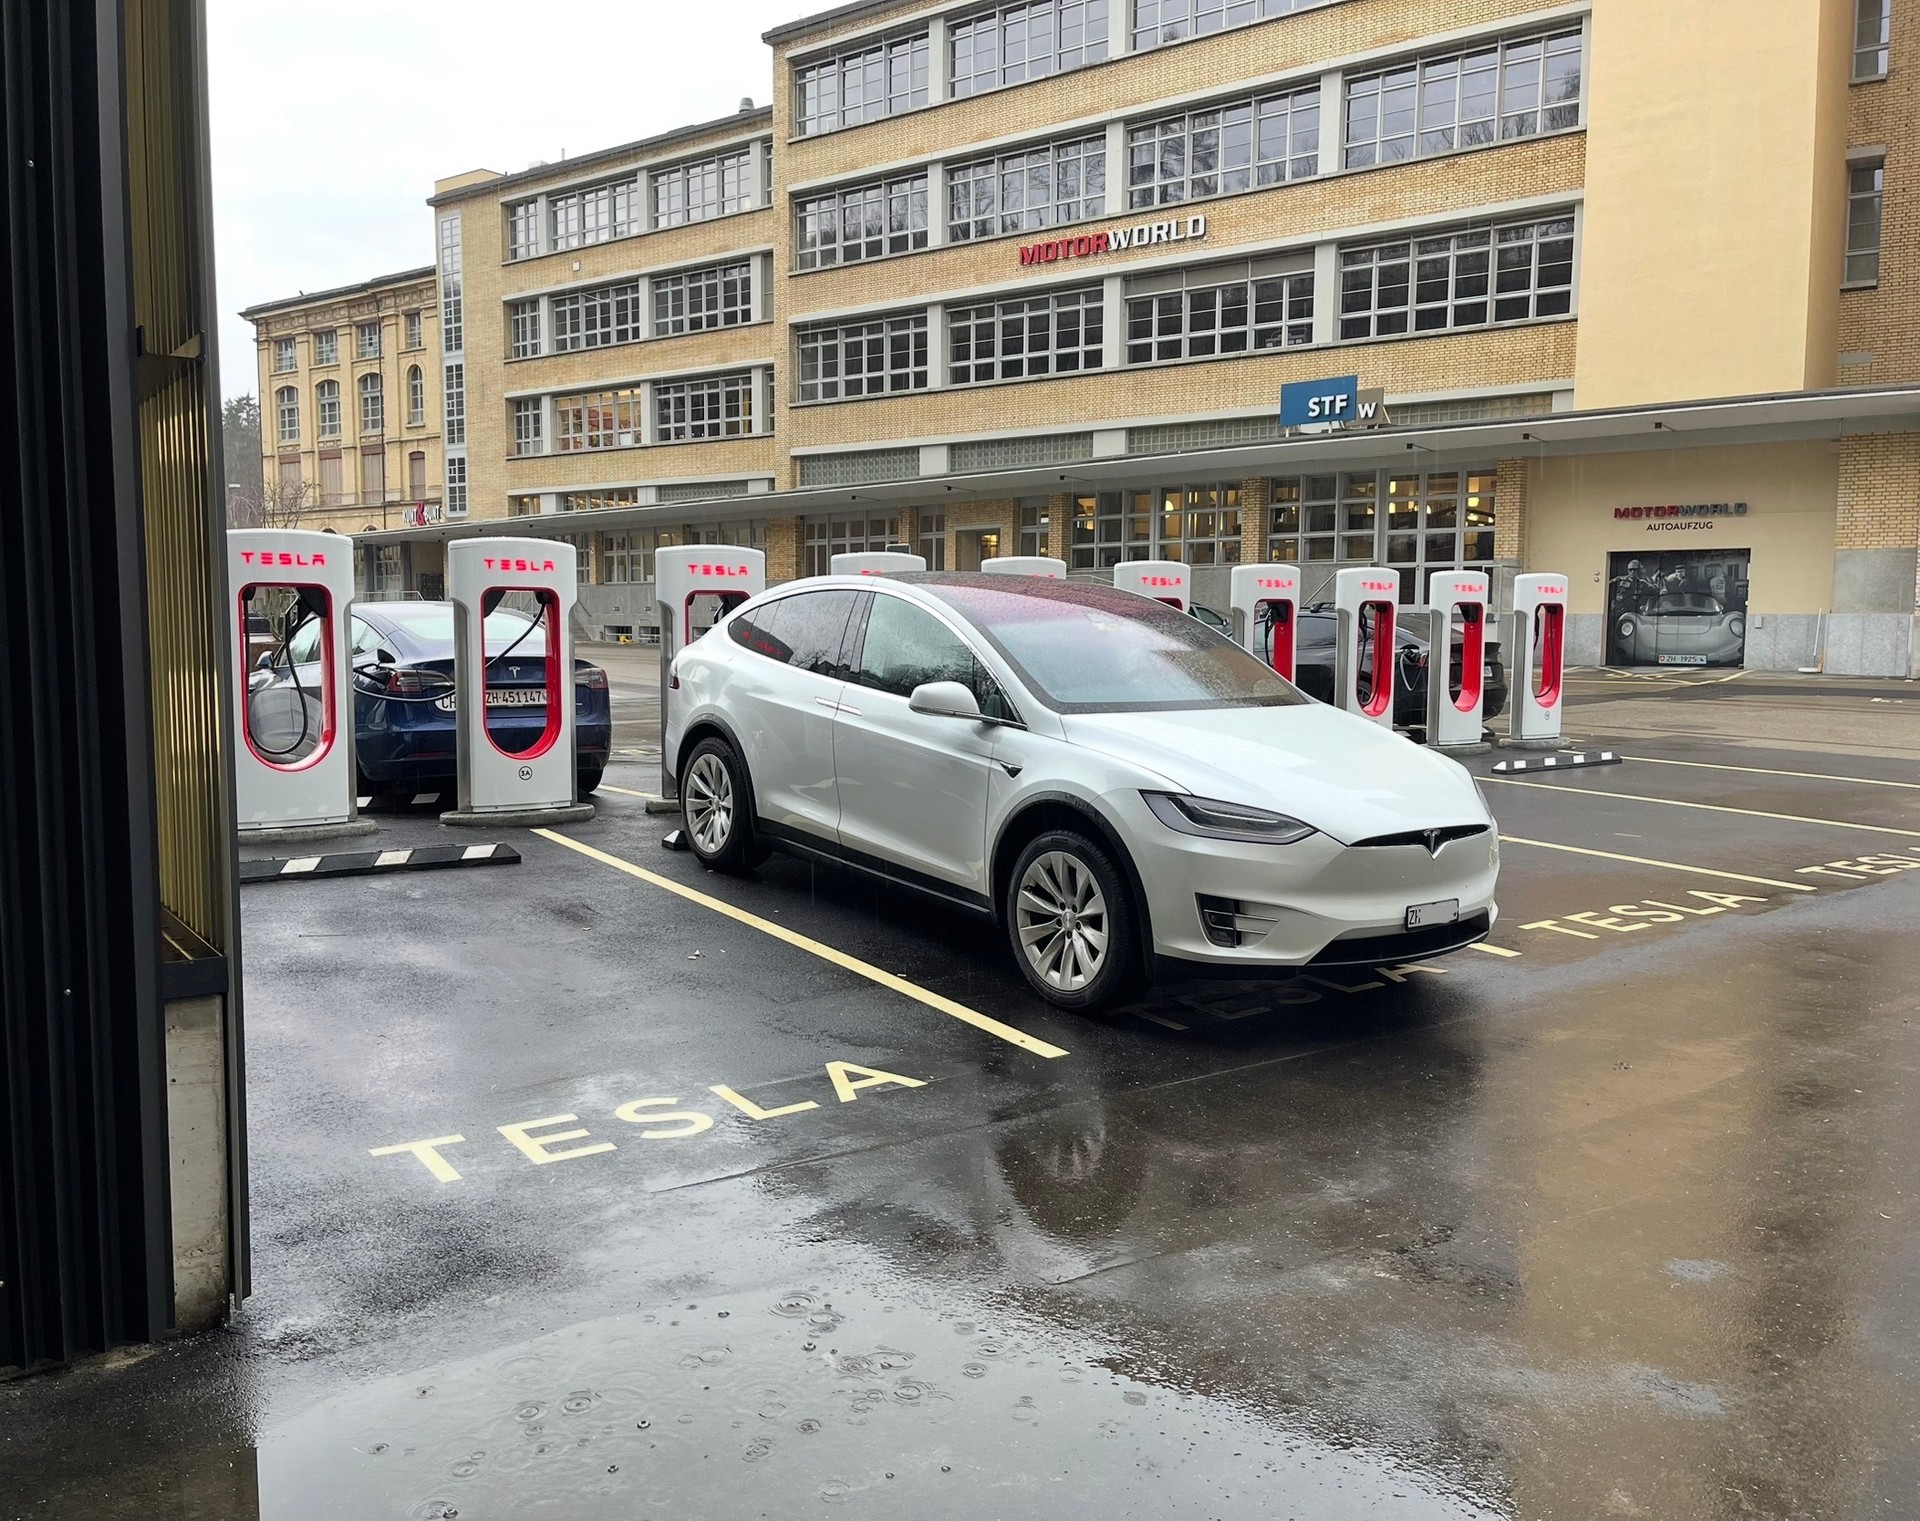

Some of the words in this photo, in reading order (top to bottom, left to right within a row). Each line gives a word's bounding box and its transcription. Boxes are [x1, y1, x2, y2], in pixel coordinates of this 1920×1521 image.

[1019, 214, 1207, 266] MOTORWORLD
[1308, 394, 1349, 417] STF
[1358, 401, 1377, 419] W
[1614, 502, 1748, 519] MOTORWORLD
[1646, 521, 1713, 531] AUTOAUFZUG
[241, 551, 326, 567] TESLA
[484, 558, 555, 571] TESLA
[689, 564, 748, 576] TESLA
[1142, 577, 1182, 586] TESLA
[1257, 579, 1293, 588] TESLA
[1362, 582, 1393, 591] TESLA
[1454, 584, 1482, 592] TESLA
[1537, 586, 1564, 594] TESLA
[1518, 889, 1766, 935] TESLA
[368, 1060, 928, 1183] TESLA
